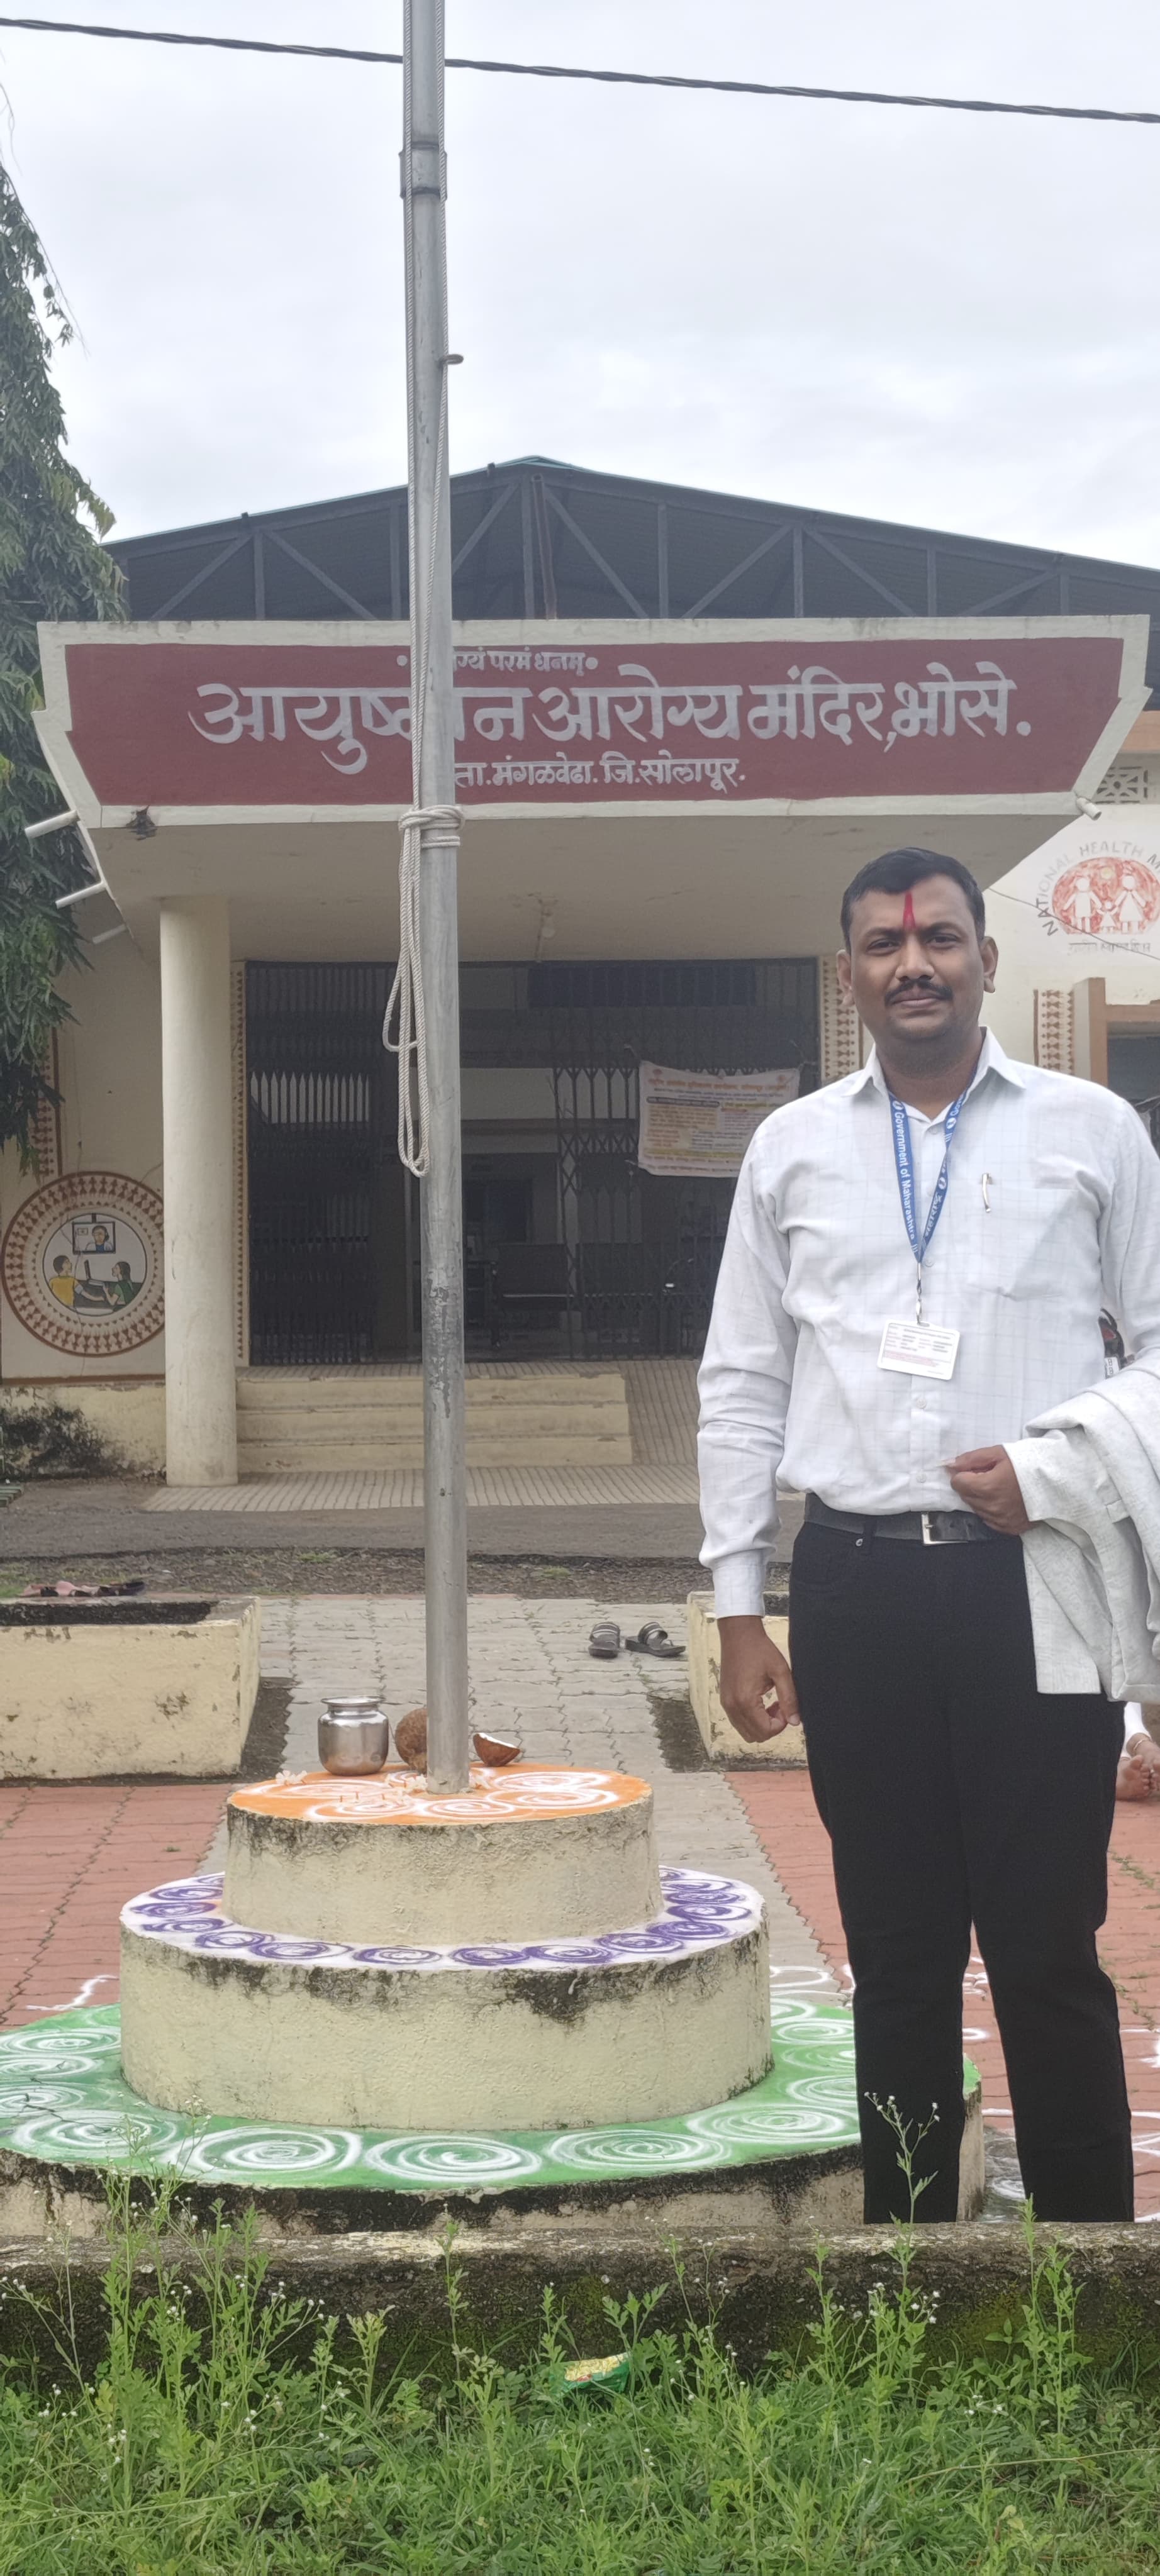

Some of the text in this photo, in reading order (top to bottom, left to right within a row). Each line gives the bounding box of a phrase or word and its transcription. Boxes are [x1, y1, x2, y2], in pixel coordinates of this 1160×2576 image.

[486, 646, 532, 672] परमं
[532, 663, 744, 742] आरोग्य
[1036, 841, 1144, 936] NATIONAL HEALTH
[895, 1111, 915, 1240] Government of Maharashtra
